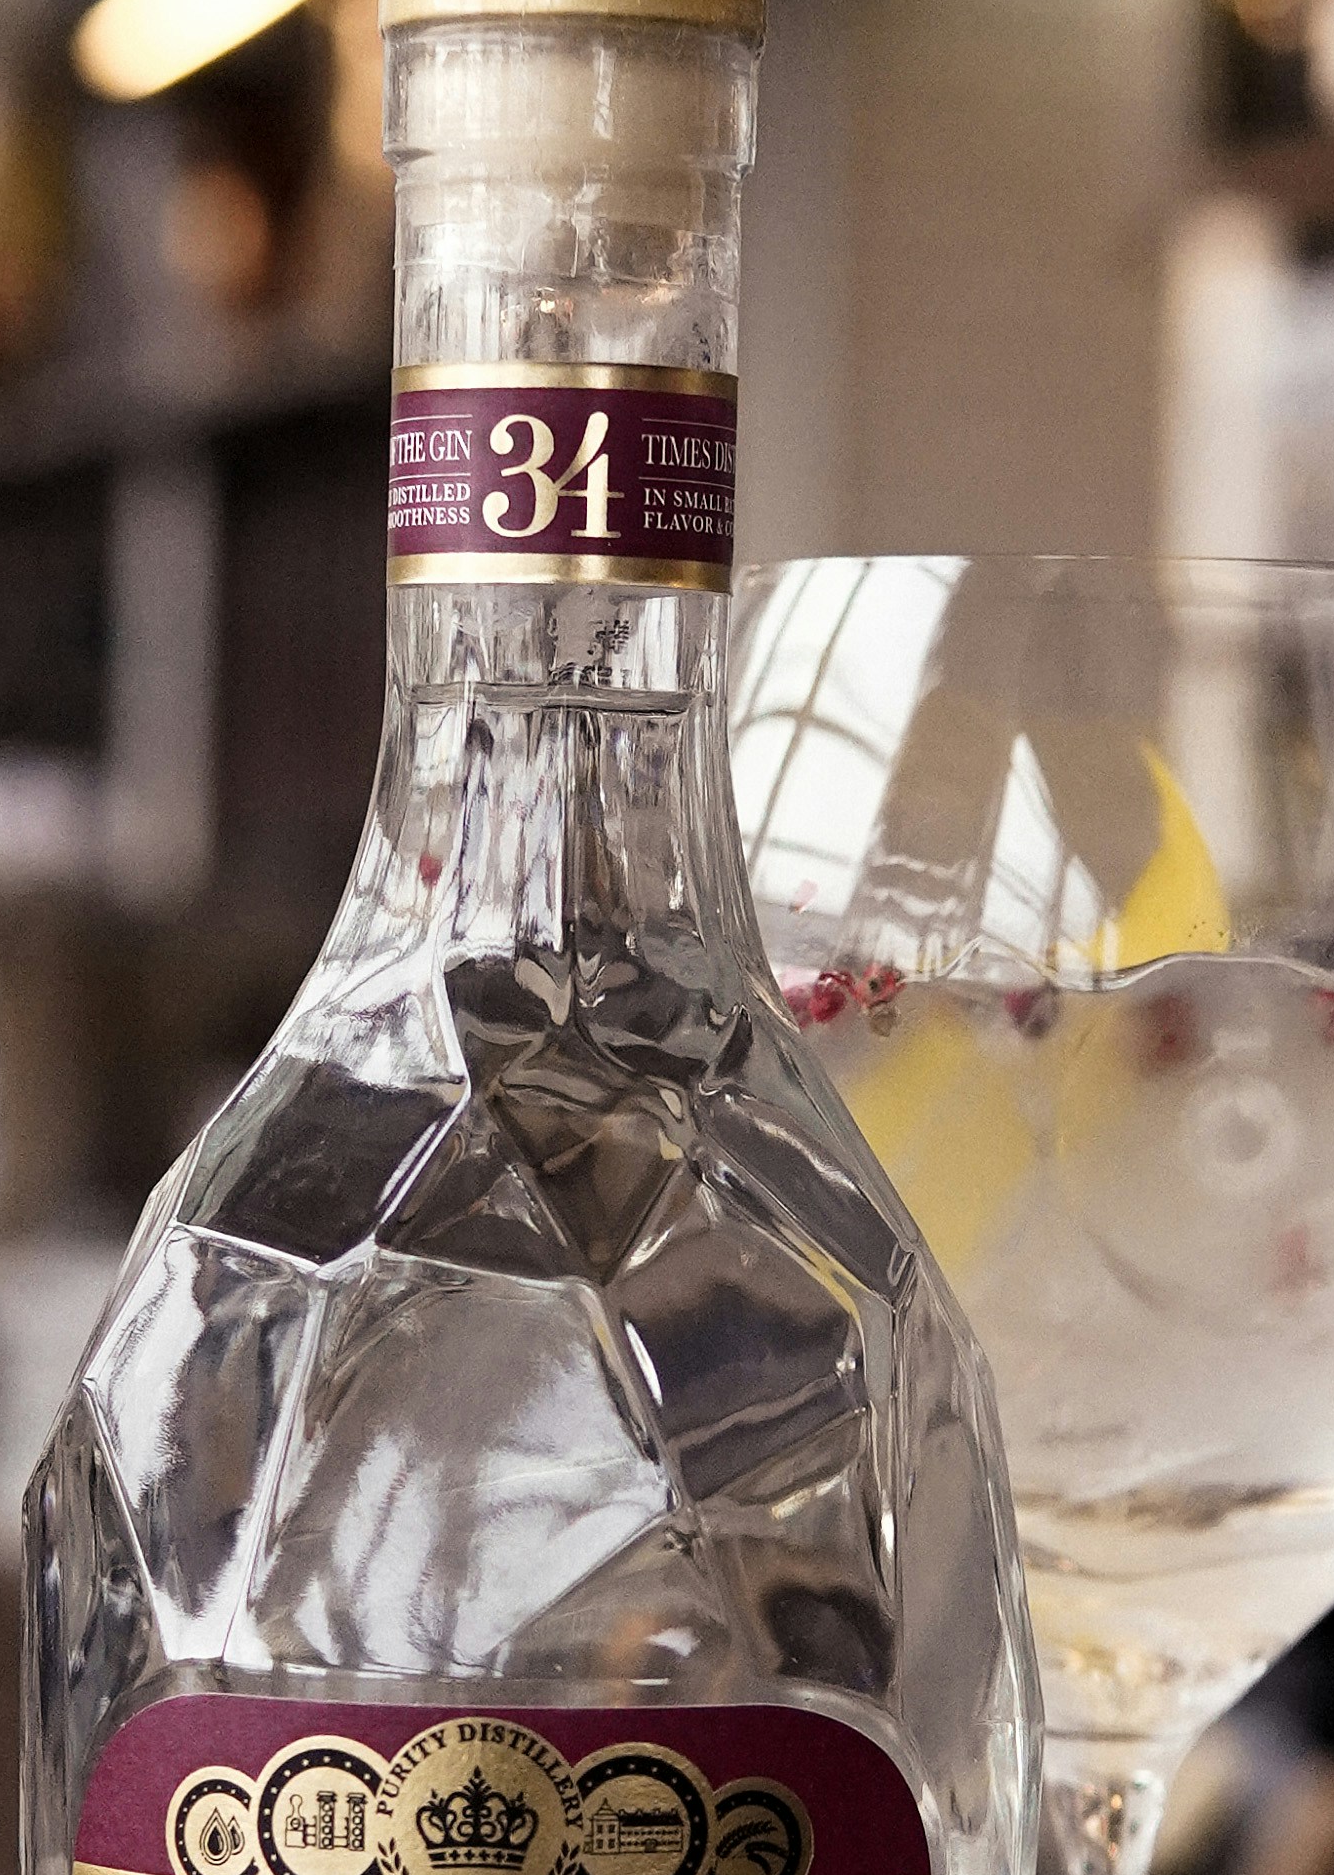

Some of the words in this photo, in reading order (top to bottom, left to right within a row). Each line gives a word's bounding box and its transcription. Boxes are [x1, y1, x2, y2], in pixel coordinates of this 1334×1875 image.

[397, 432, 426, 464] THE
[429, 430, 472, 461] GIN
[641, 434, 710, 469] TIMES
[482, 411, 624, 538] 34
[644, 488, 666, 505] IN
[673, 490, 722, 512] SMALL
[643, 511, 713, 534] FLAVOR
[376, 1729, 447, 1818] PURITY
[457, 1723, 583, 1829] DISTILLERY
